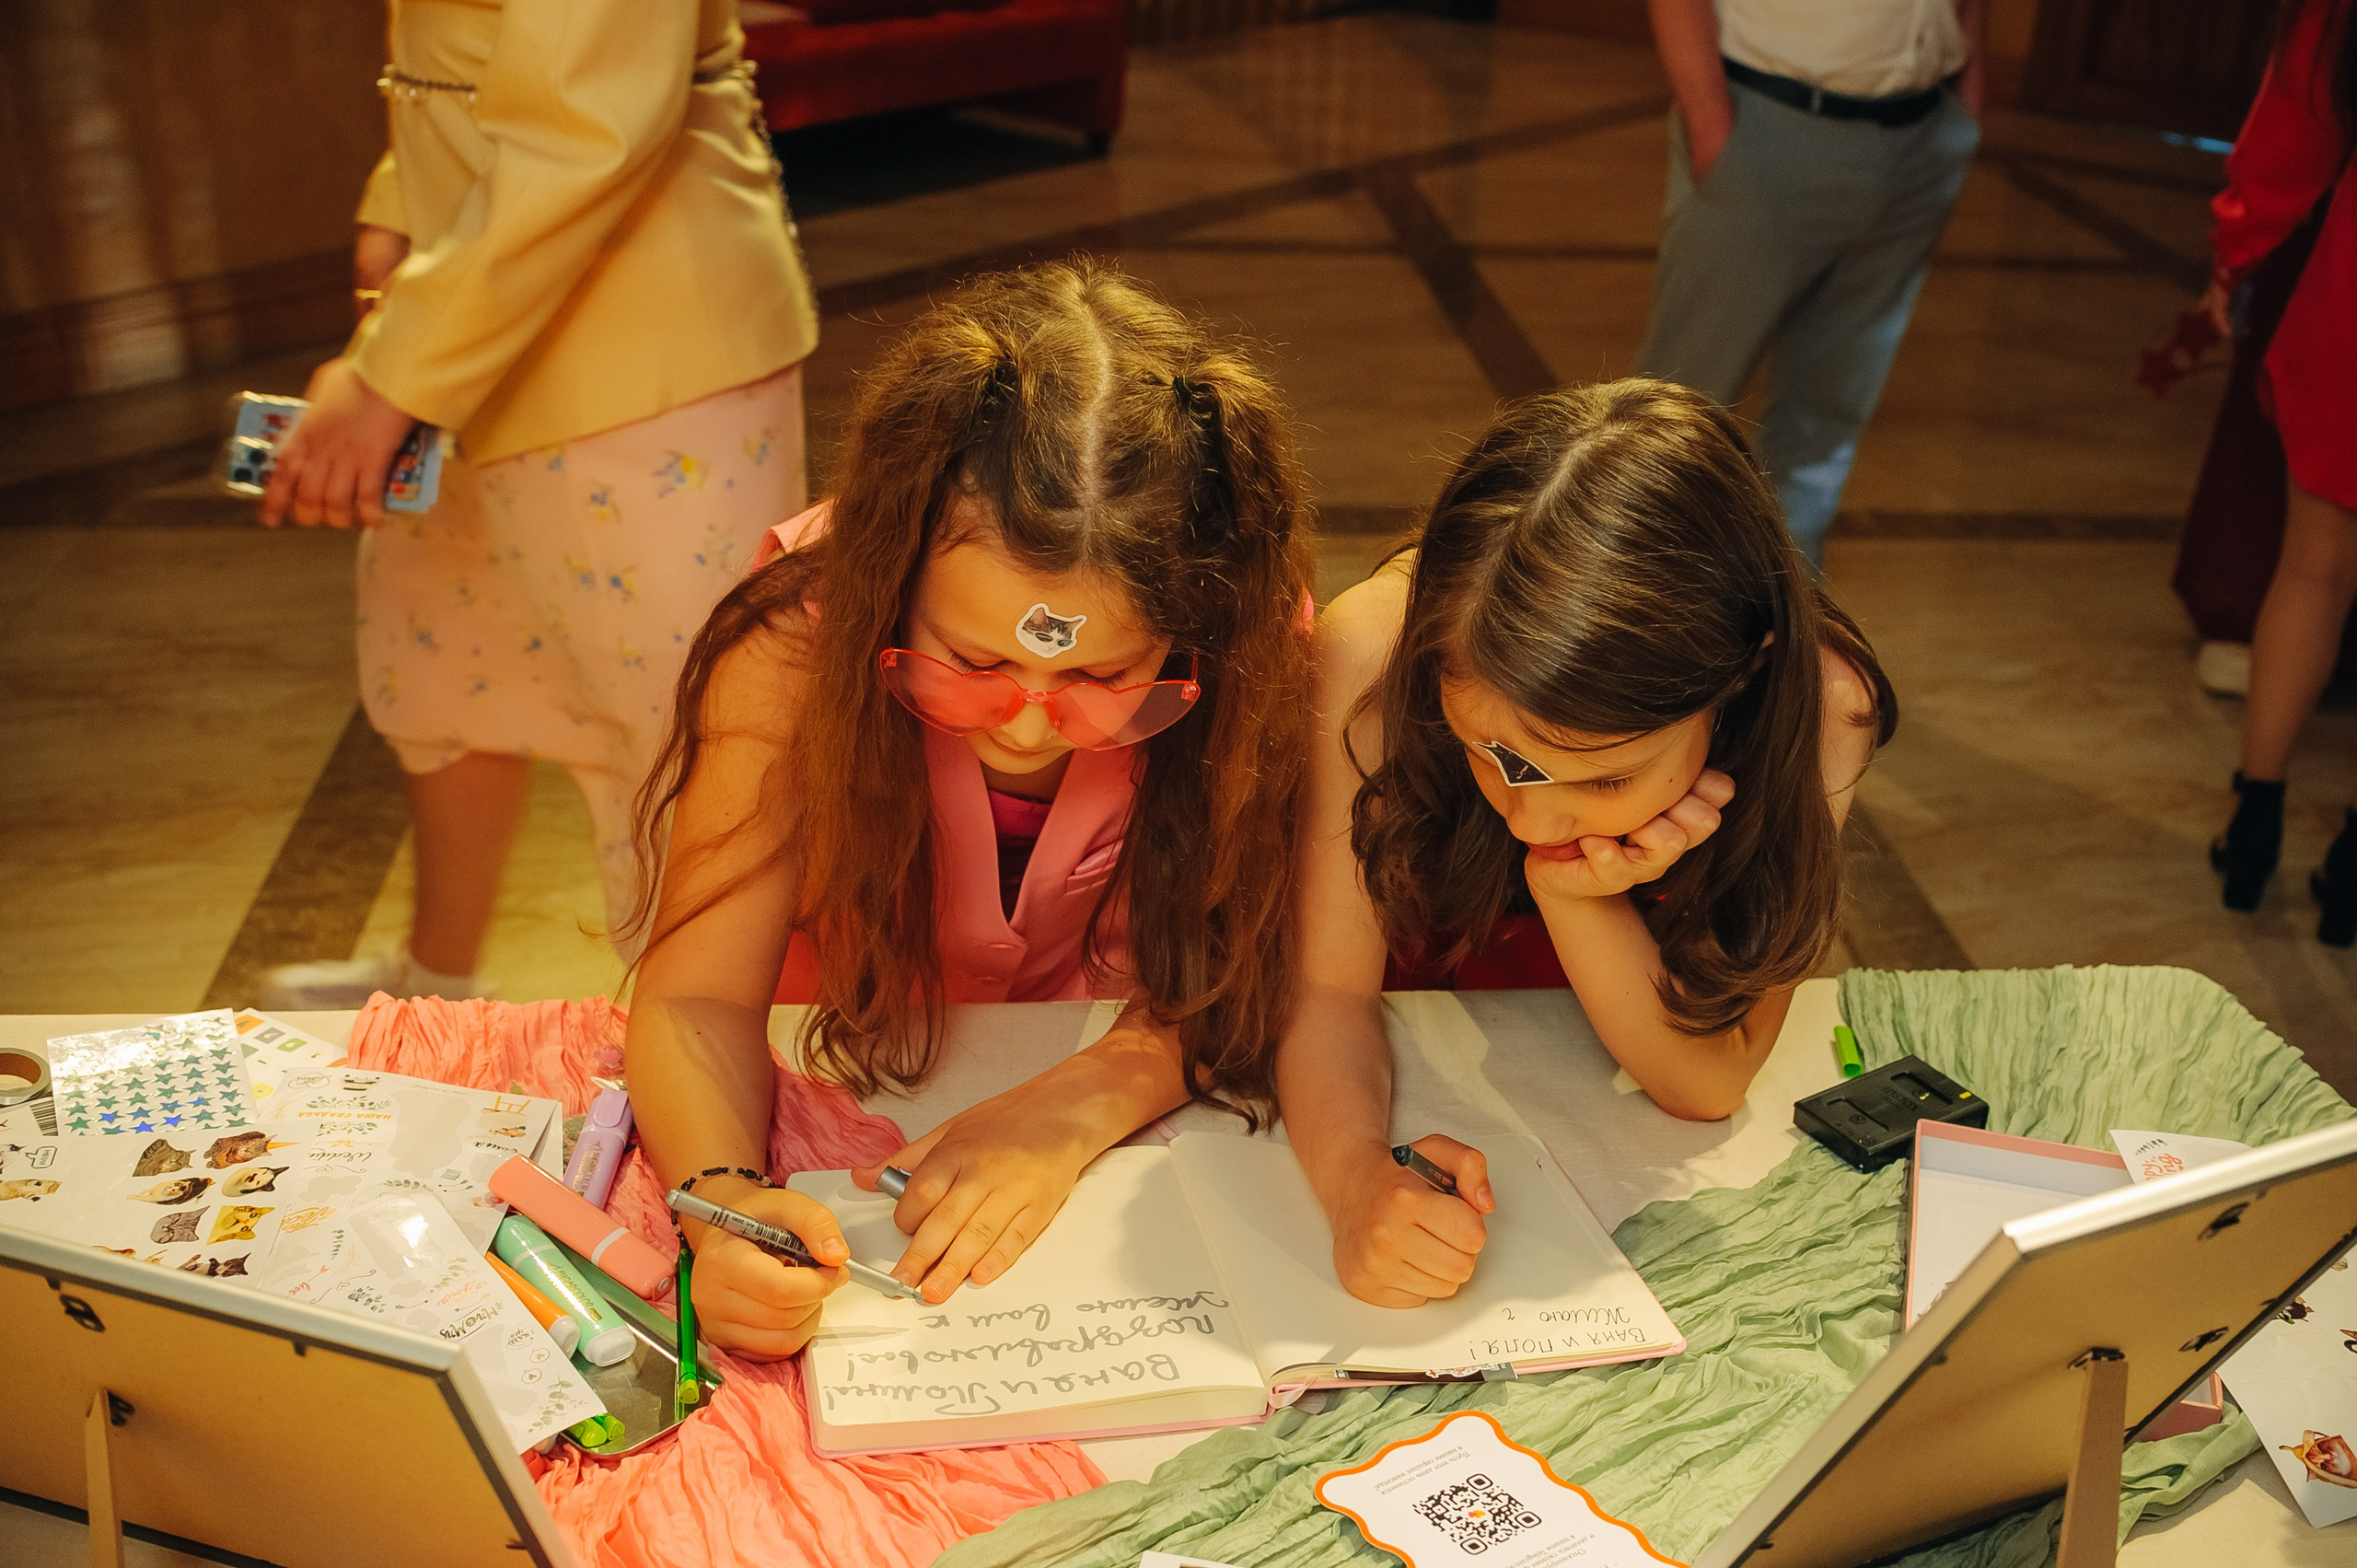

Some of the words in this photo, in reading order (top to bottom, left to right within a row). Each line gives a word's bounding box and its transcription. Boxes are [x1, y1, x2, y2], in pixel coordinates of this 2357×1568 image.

[297, 1110, 352, 1119] СВАДЬБА
[1041, 1353, 1180, 1393] Ваня
[999, 1380, 1039, 1395] и
[1435, 1448, 1457, 1461] наших
[1448, 1451, 1470, 1463] Пусть
[1407, 1458, 1434, 1474] сердцах
[1434, 1459, 1449, 1470] этот
[1417, 1468, 1433, 1478] день
[1373, 1471, 1406, 1492] навсегда!
[1381, 1475, 1416, 1495] останется
[1546, 1537, 1571, 1551] нашем
[1557, 1536, 1588, 1554] делитесь
